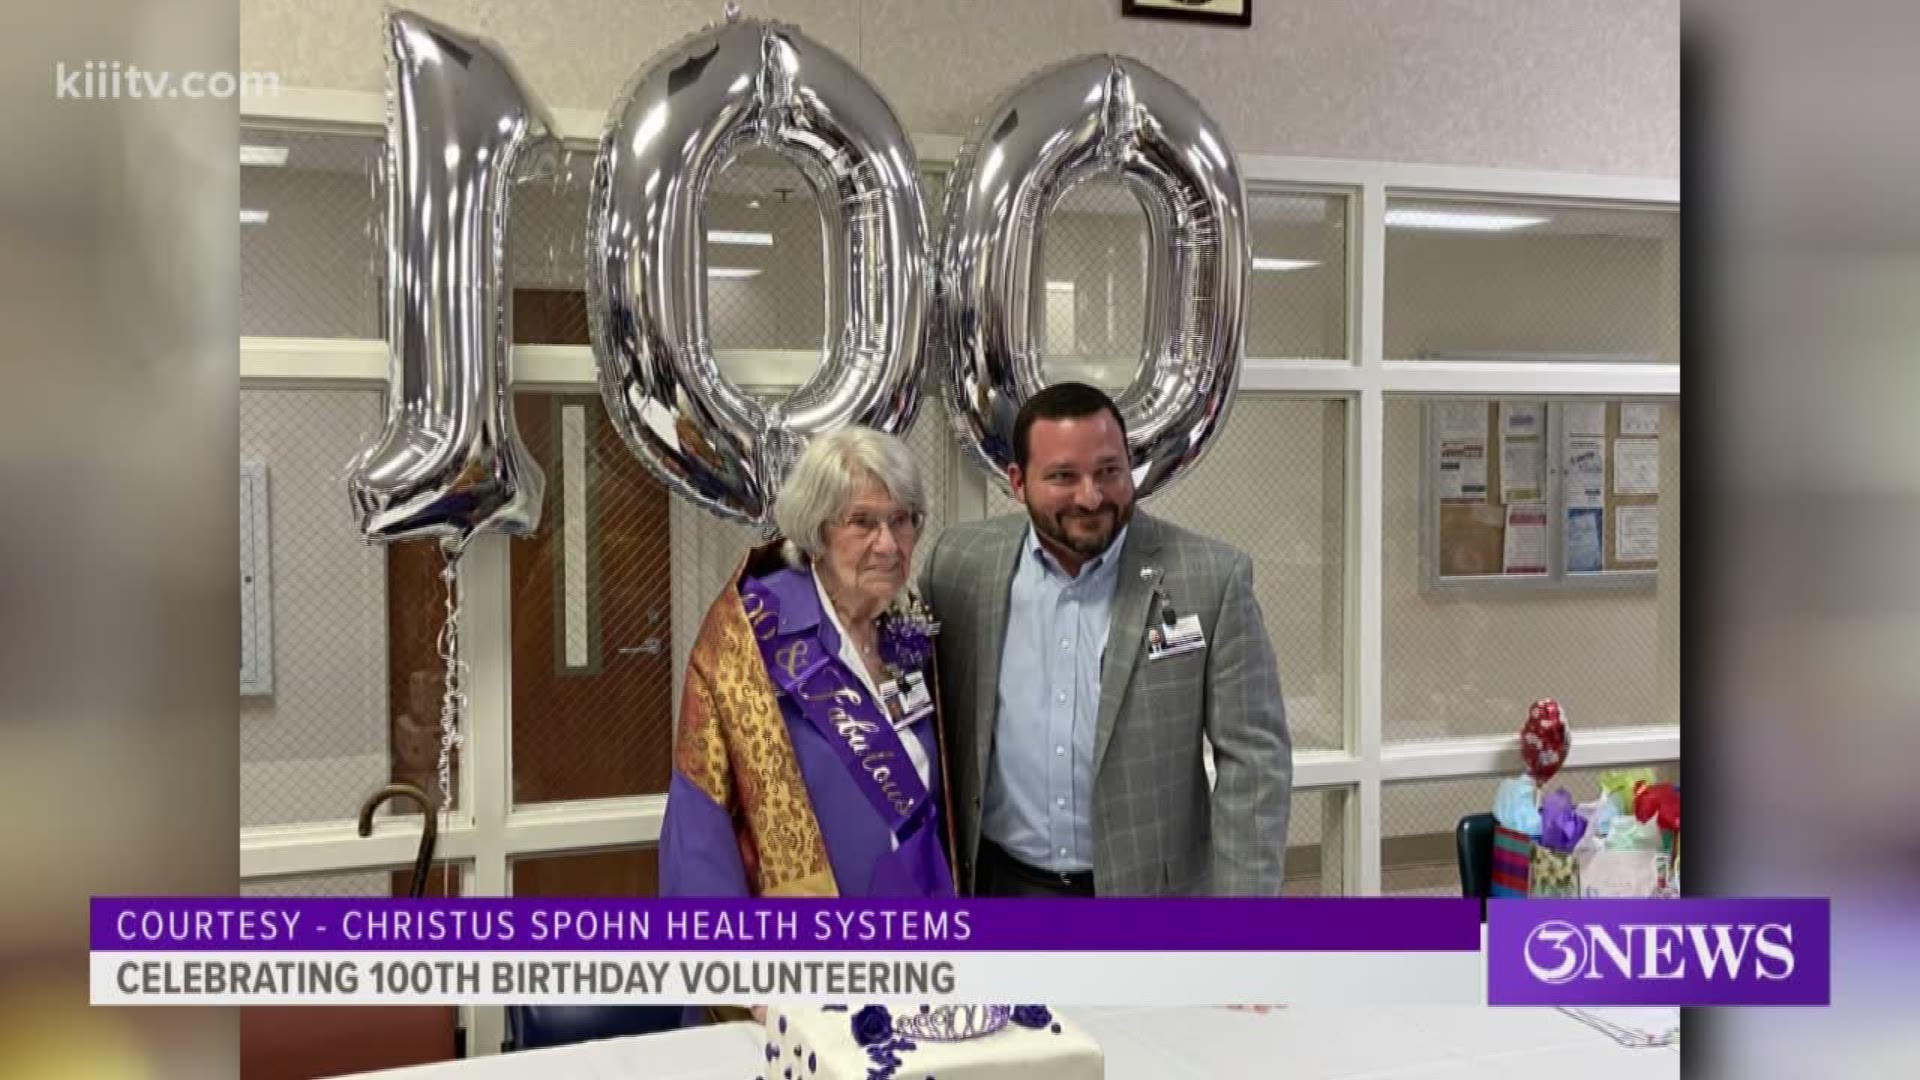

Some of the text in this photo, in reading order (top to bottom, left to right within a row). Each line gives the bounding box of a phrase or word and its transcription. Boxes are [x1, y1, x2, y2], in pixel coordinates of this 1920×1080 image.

[350, 8, 1250, 542] 100
[742, 593, 779, 640] 00
[774, 640, 808, 680] &
[799, 667, 917, 816] Fabulous
